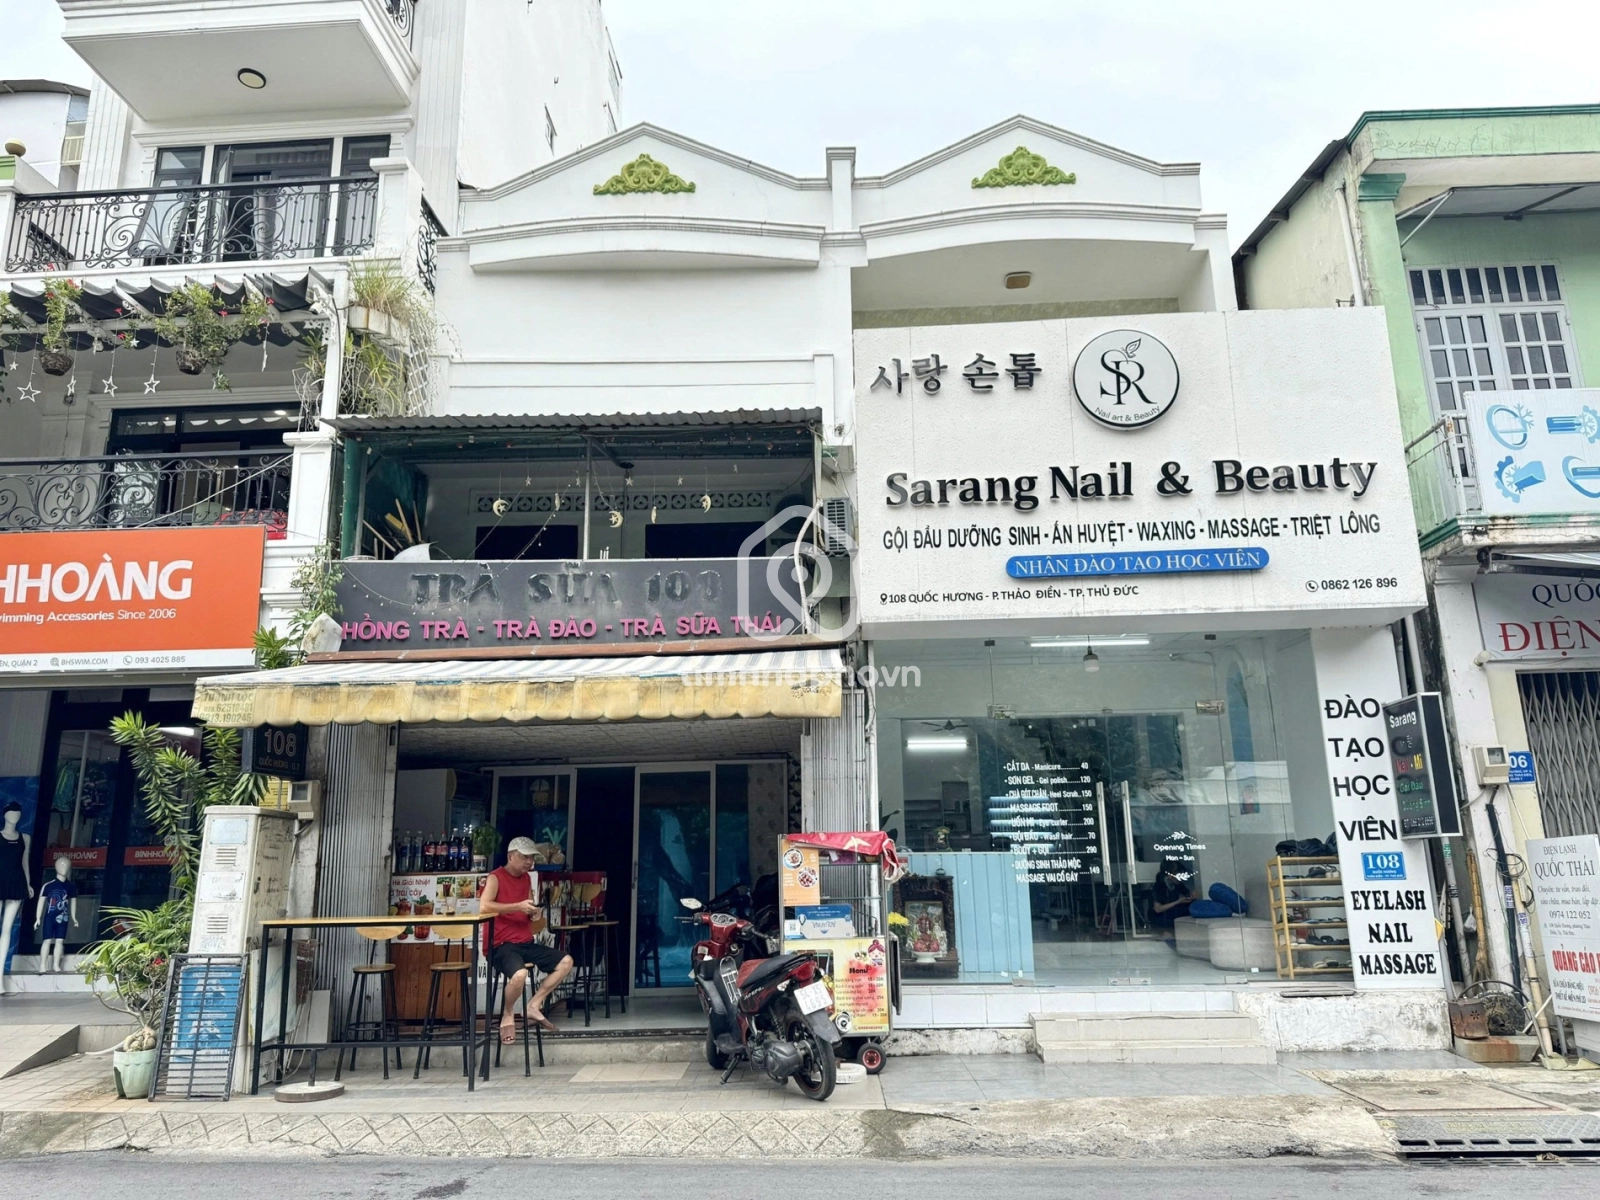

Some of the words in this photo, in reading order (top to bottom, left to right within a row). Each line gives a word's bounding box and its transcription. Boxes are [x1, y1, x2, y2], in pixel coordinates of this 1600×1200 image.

[870, 353, 948, 395] 사랑
[962, 352, 1042, 391] 손톱
[1094, 406, 1111, 418] Nail
[1133, 405, 1161, 420] Beauty
[885, 472, 1040, 513] Sarang
[1048, 461, 1135, 500] Nail
[1156, 460, 1193, 496] &
[1212, 457, 1378, 498] Beauty
[883, 526, 908, 553] GỘI
[913, 524, 942, 549] ĐẦU
[948, 523, 1001, 548] DƯỠNG
[1008, 525, 1040, 546] SINH
[1052, 520, 1073, 544] ẤN
[1078, 520, 1126, 547] HUYỆT
[1136, 519, 1196, 541] WAXING
[1207, 517, 1280, 539] MASSAGE
[1290, 514, 1332, 540] TRIỆT
[1340, 510, 1380, 534] LÔNG
[1015, 556, 1069, 576] NHẬN
[1073, 554, 1116, 573] ĐÀO
[1166, 552, 1210, 571] HỌC
[1214, 548, 1261, 567] VIÊN
[1320, 579, 1350, 590] 0862
[1352, 578, 1372, 589] 126
[1376, 577, 1398, 588] 896
[1532, 571, 1600, 609] QUỐ
[888, 594, 906, 604] 108
[908, 590, 939, 604] QUỐC
[942, 591, 984, 602] HƯƠNG
[1035, 586, 1061, 598] ĐIỀN
[1068, 588, 1085, 598] TP.
[1087, 585, 1110, 597] THỦ
[1114, 585, 1139, 596] ĐỨC
[46, 610, 114, 622] Accessories
[117, 609, 146, 620] Since
[148, 608, 177, 620] 2006
[420, 616, 469, 640] TRÀ
[492, 616, 542, 640] TRÀ
[548, 614, 596, 638] ĐÀO
[620, 612, 667, 637] TRÀ
[676, 611, 721, 636] SỮA
[730, 610, 781, 634] THÁI
[60, 658, 109, 666] BHSWIM.COM
[134, 656, 149, 664] 093
[150, 656, 170, 664] 4025
[172, 656, 186, 664] 885
[1324, 693, 1380, 719] ĐÀO
[1389, 711, 1418, 728] Sarang
[264, 728, 297, 758] 108
[1328, 737, 1385, 763] TẠO
[1020, 762, 1030, 771] DA
[1022, 776, 1035, 784] GEL
[1333, 774, 1390, 801] HỌC
[1010, 803, 1040, 812] MASSAGE
[1041, 803, 1058, 812] FOOT
[1338, 816, 1398, 841] VIÊN
[1014, 846, 1031, 855] BODY
[1086, 846, 1097, 854] 290
[1153, 844, 1185, 852] Opening
[1543, 845, 1558, 856] ĐIỆN
[1559, 844, 1577, 856] LẠNH
[1036, 860, 1051, 869] SINH
[1366, 854, 1400, 870] 108
[1535, 855, 1566, 880] QUỐC
[1566, 855, 1596, 876] THÁI
[1016, 873, 1045, 883] MASSAGE
[1046, 873, 1056, 882] VAI
[1350, 890, 1426, 911] EYELASH
[1549, 910, 1564, 919] 0974
[1565, 911, 1578, 919] 122
[1578, 911, 1591, 919] 052
[1368, 922, 1414, 944] NAIL
[1358, 953, 1437, 976] MASSAGE
[1552, 943, 1579, 972] QUẢNG
[1579, 946, 1597, 974] CÁO
